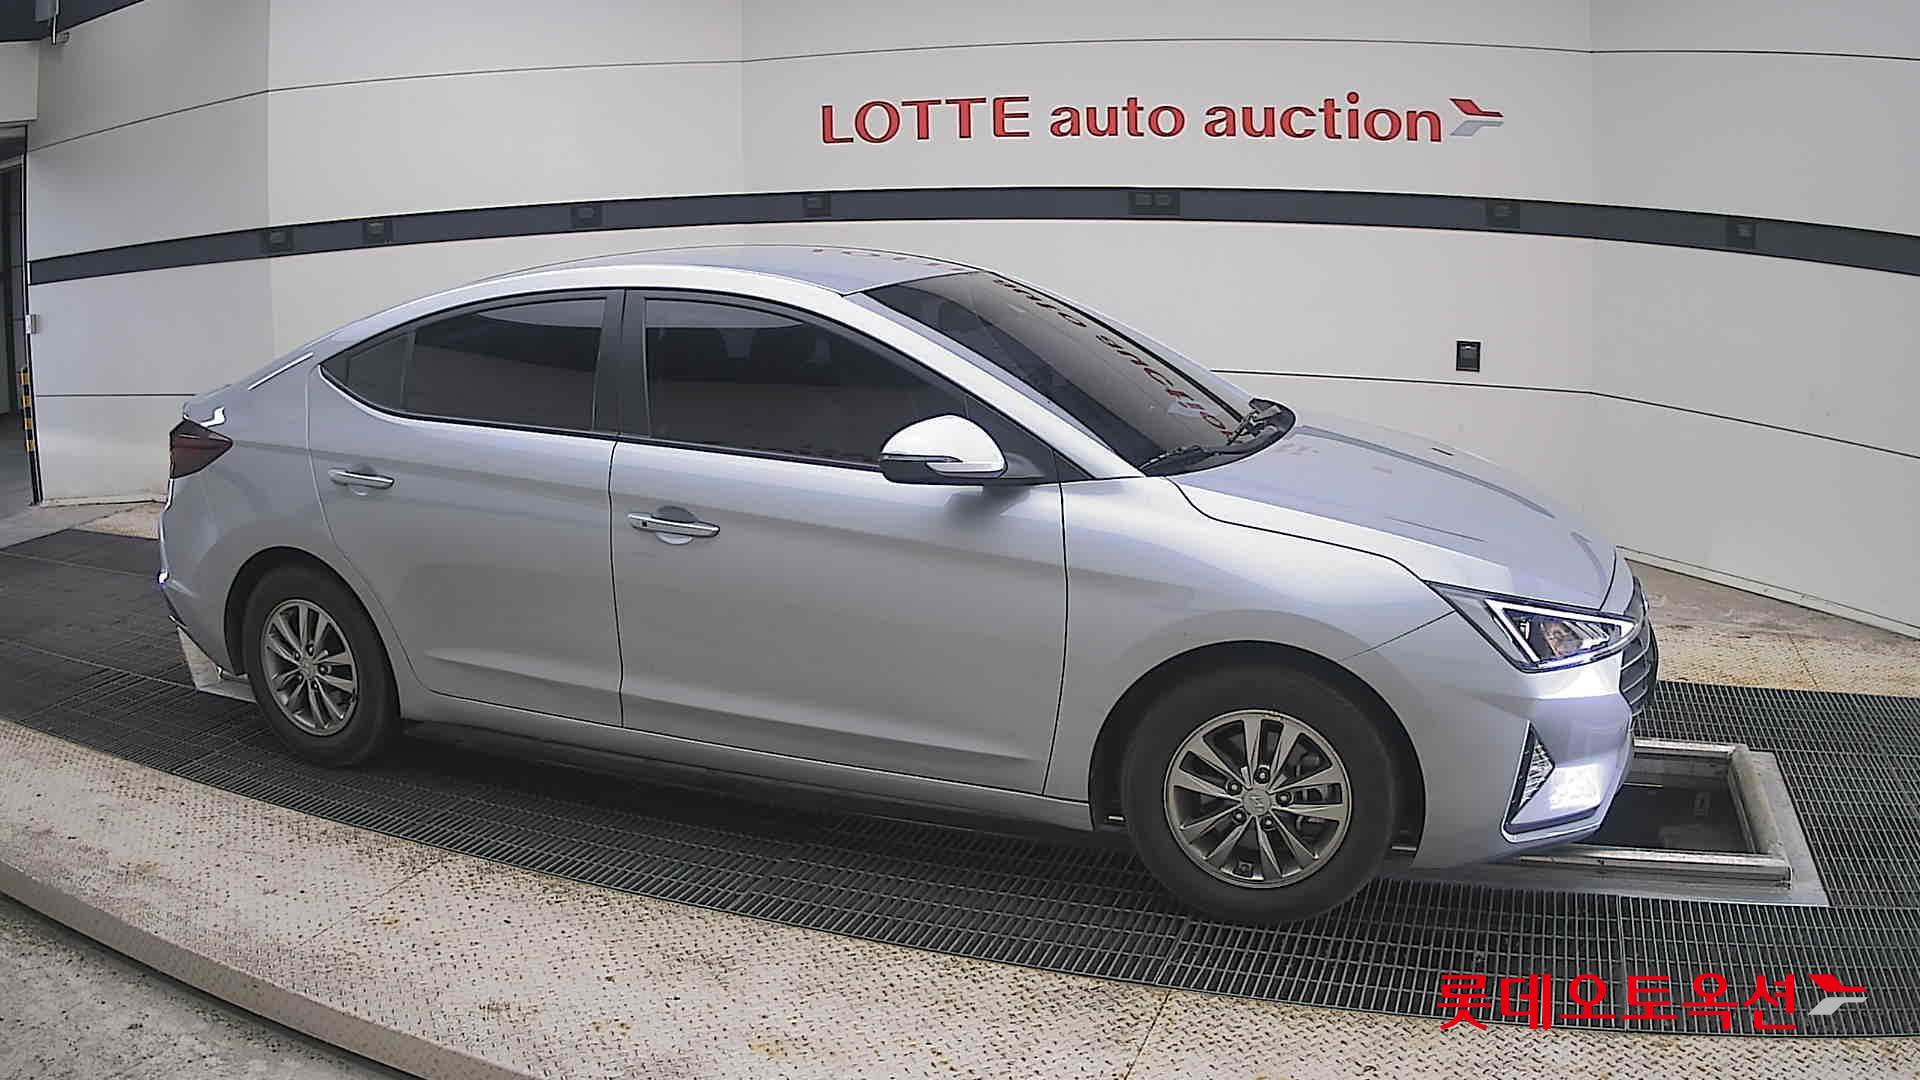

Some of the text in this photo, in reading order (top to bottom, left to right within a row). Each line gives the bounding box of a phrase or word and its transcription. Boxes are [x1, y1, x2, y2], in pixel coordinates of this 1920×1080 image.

[820, 91, 1443, 144] LOTTE auto auction
